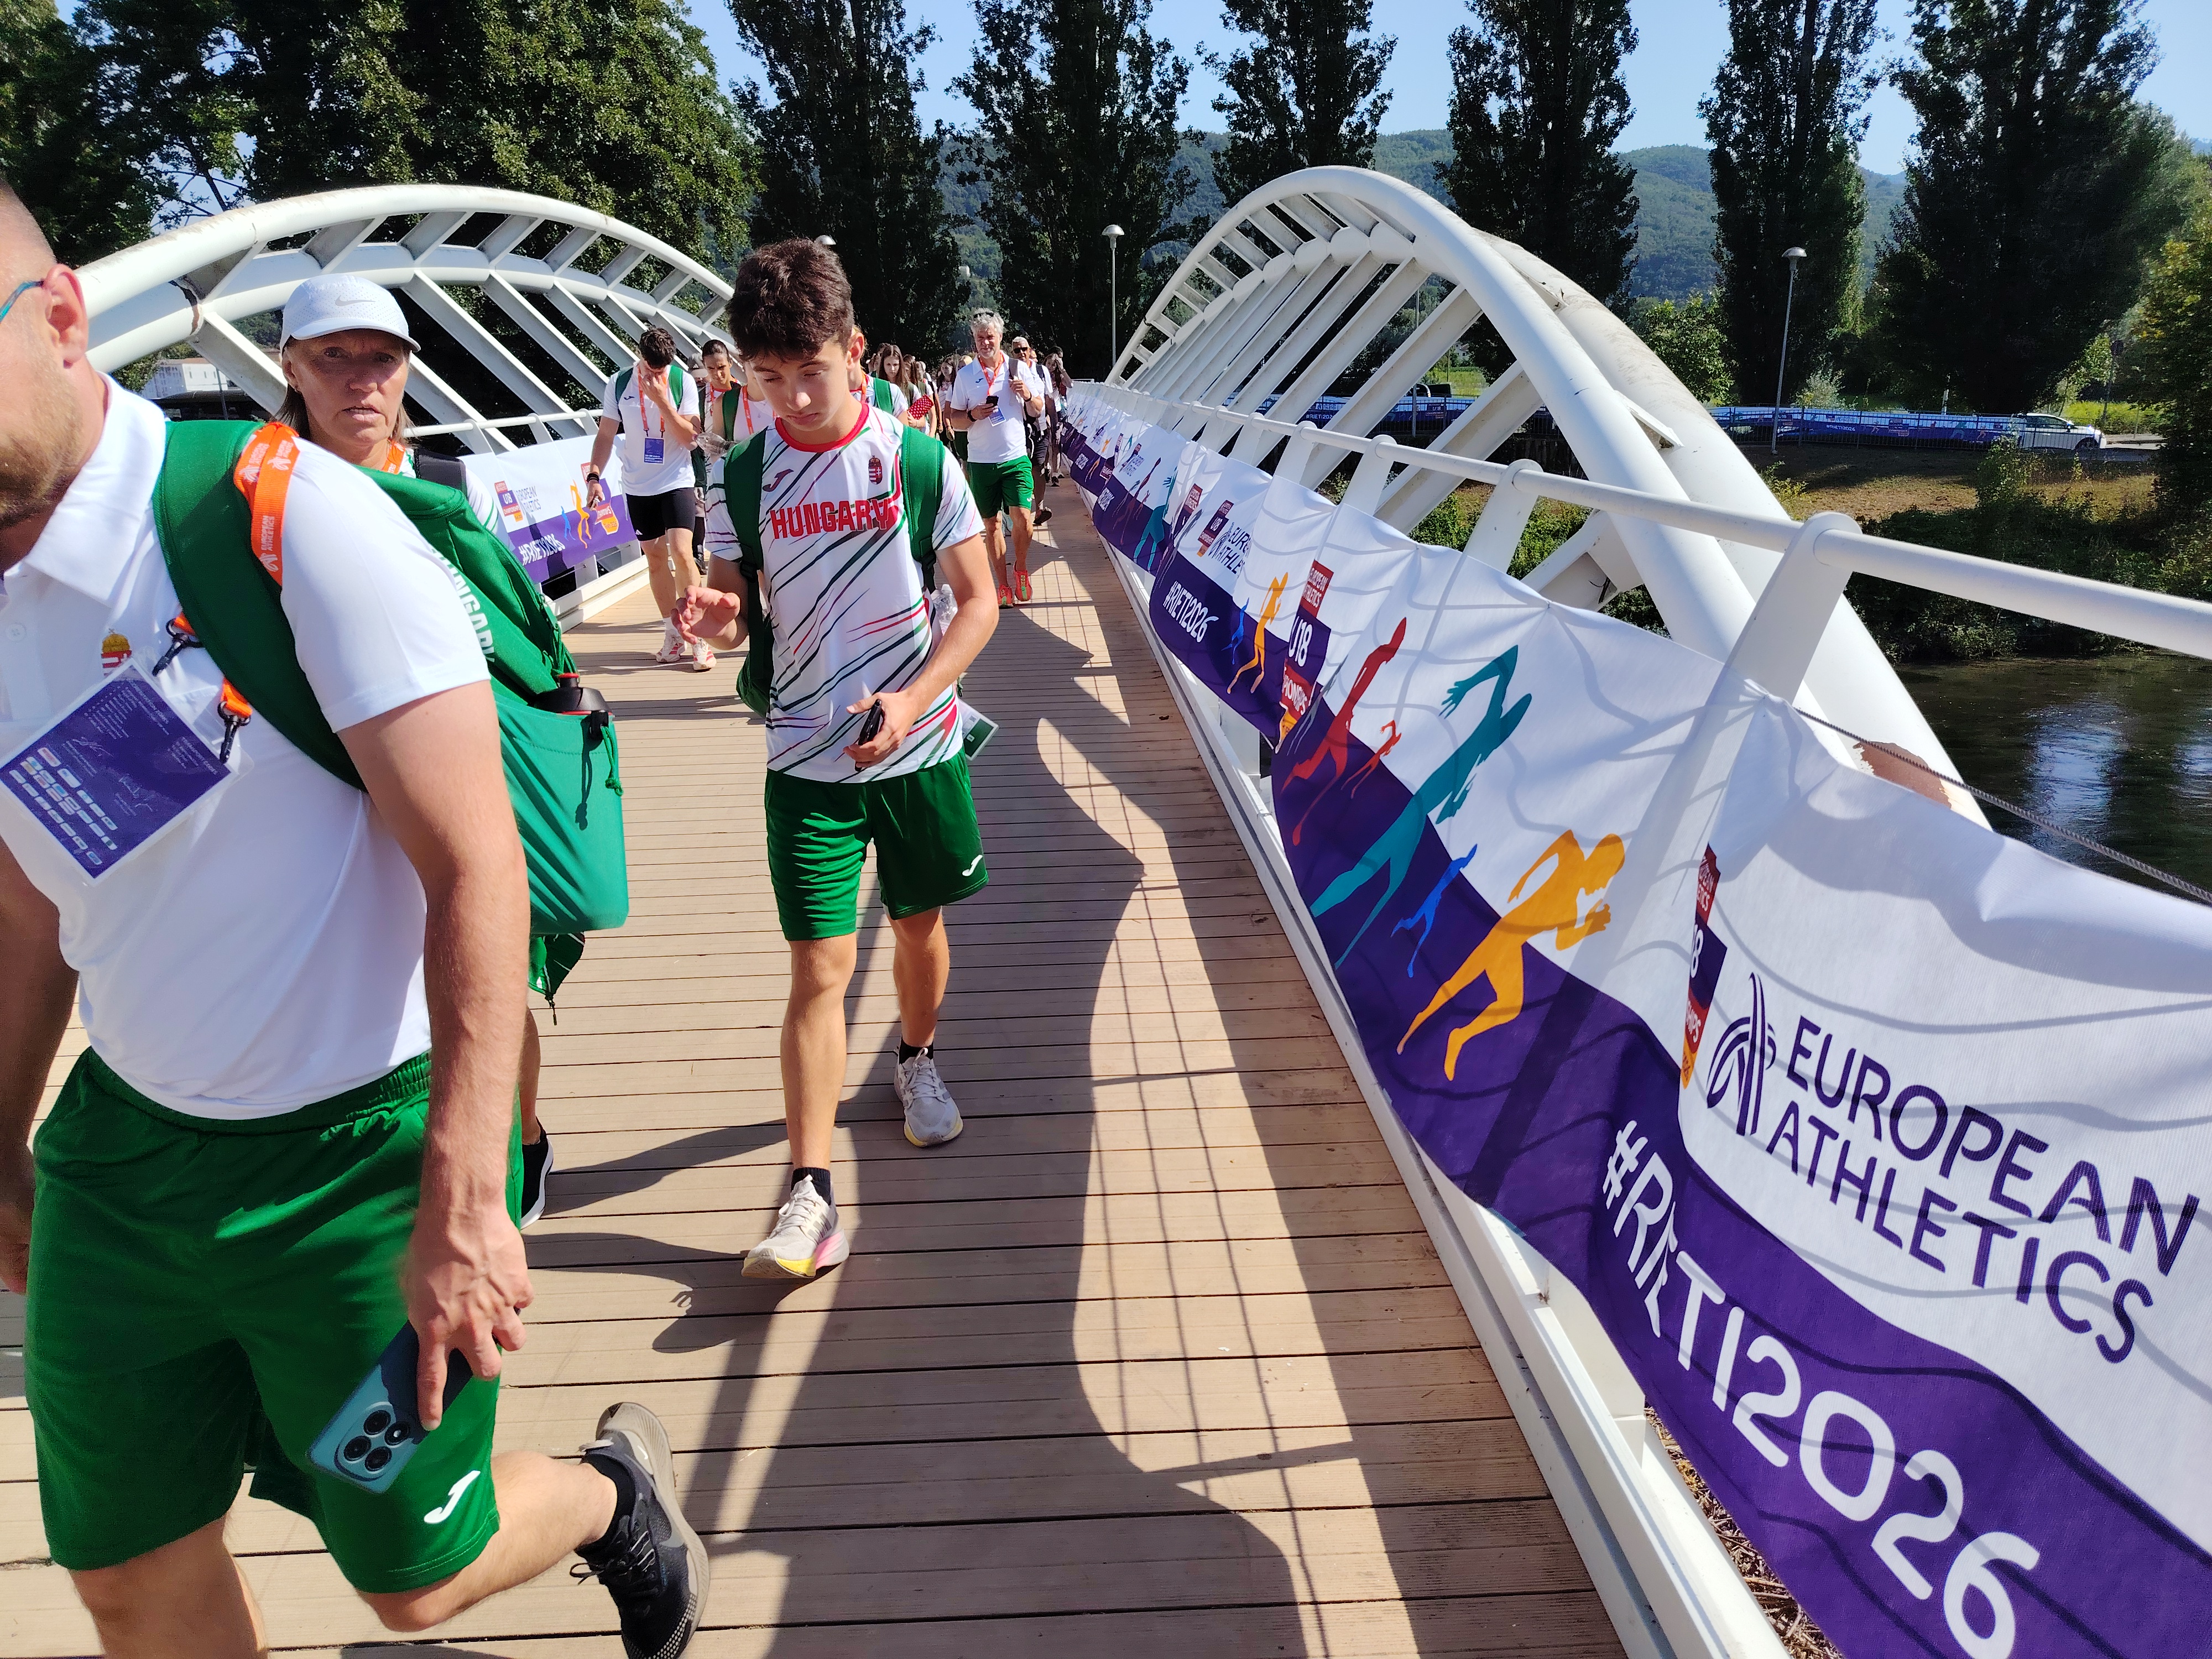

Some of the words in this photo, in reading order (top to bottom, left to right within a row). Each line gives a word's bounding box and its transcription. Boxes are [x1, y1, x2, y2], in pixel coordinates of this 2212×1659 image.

[770, 498, 888, 539] HUNGARY
[519, 533, 565, 566] #RIETI2026
[1162, 581, 1219, 642] #RIETI2026
[1288, 615, 1313, 667] U18
[1786, 1015, 2200, 1276] EUROPEAN
[1766, 1100, 2153, 1364] ATHLETICS
